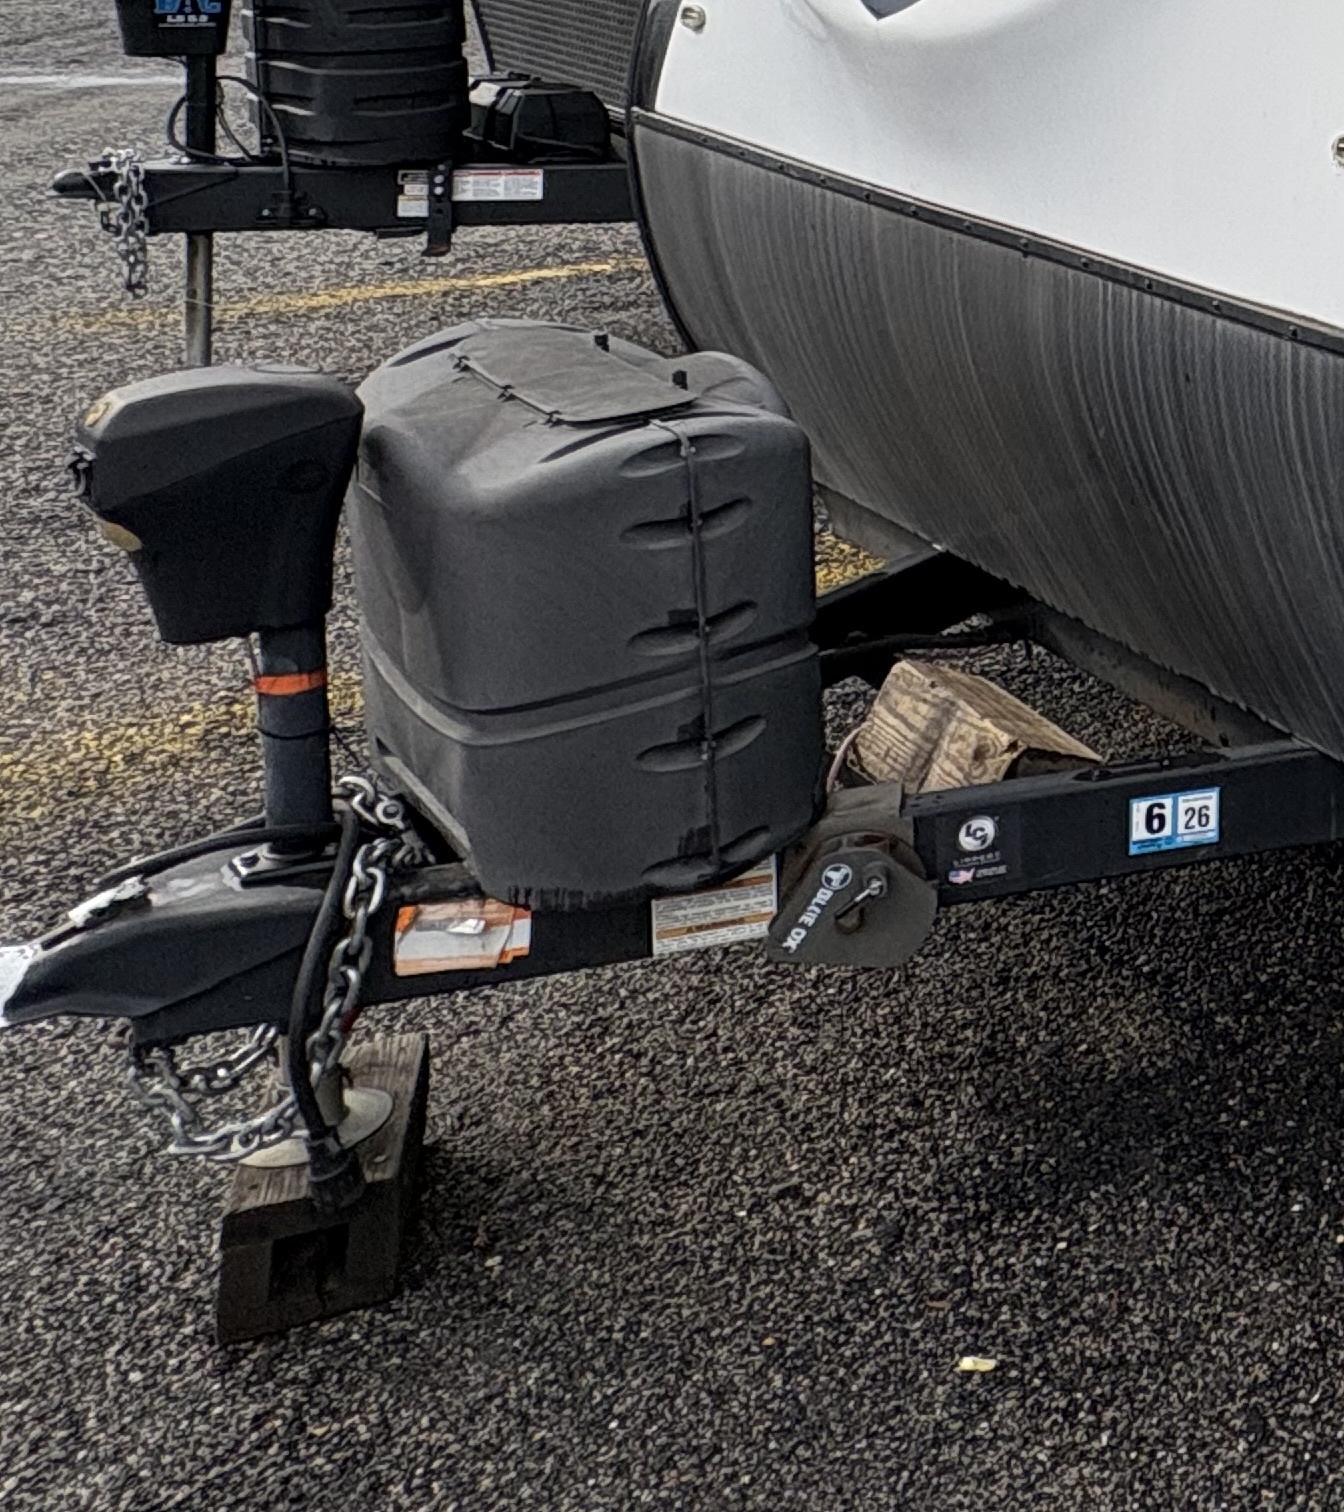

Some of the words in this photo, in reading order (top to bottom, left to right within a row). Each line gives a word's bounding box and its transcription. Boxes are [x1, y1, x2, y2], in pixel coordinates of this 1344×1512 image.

[1144, 802, 1167, 836] 6
[1184, 804, 1211, 830] 26
[781, 927, 808, 954] OX
